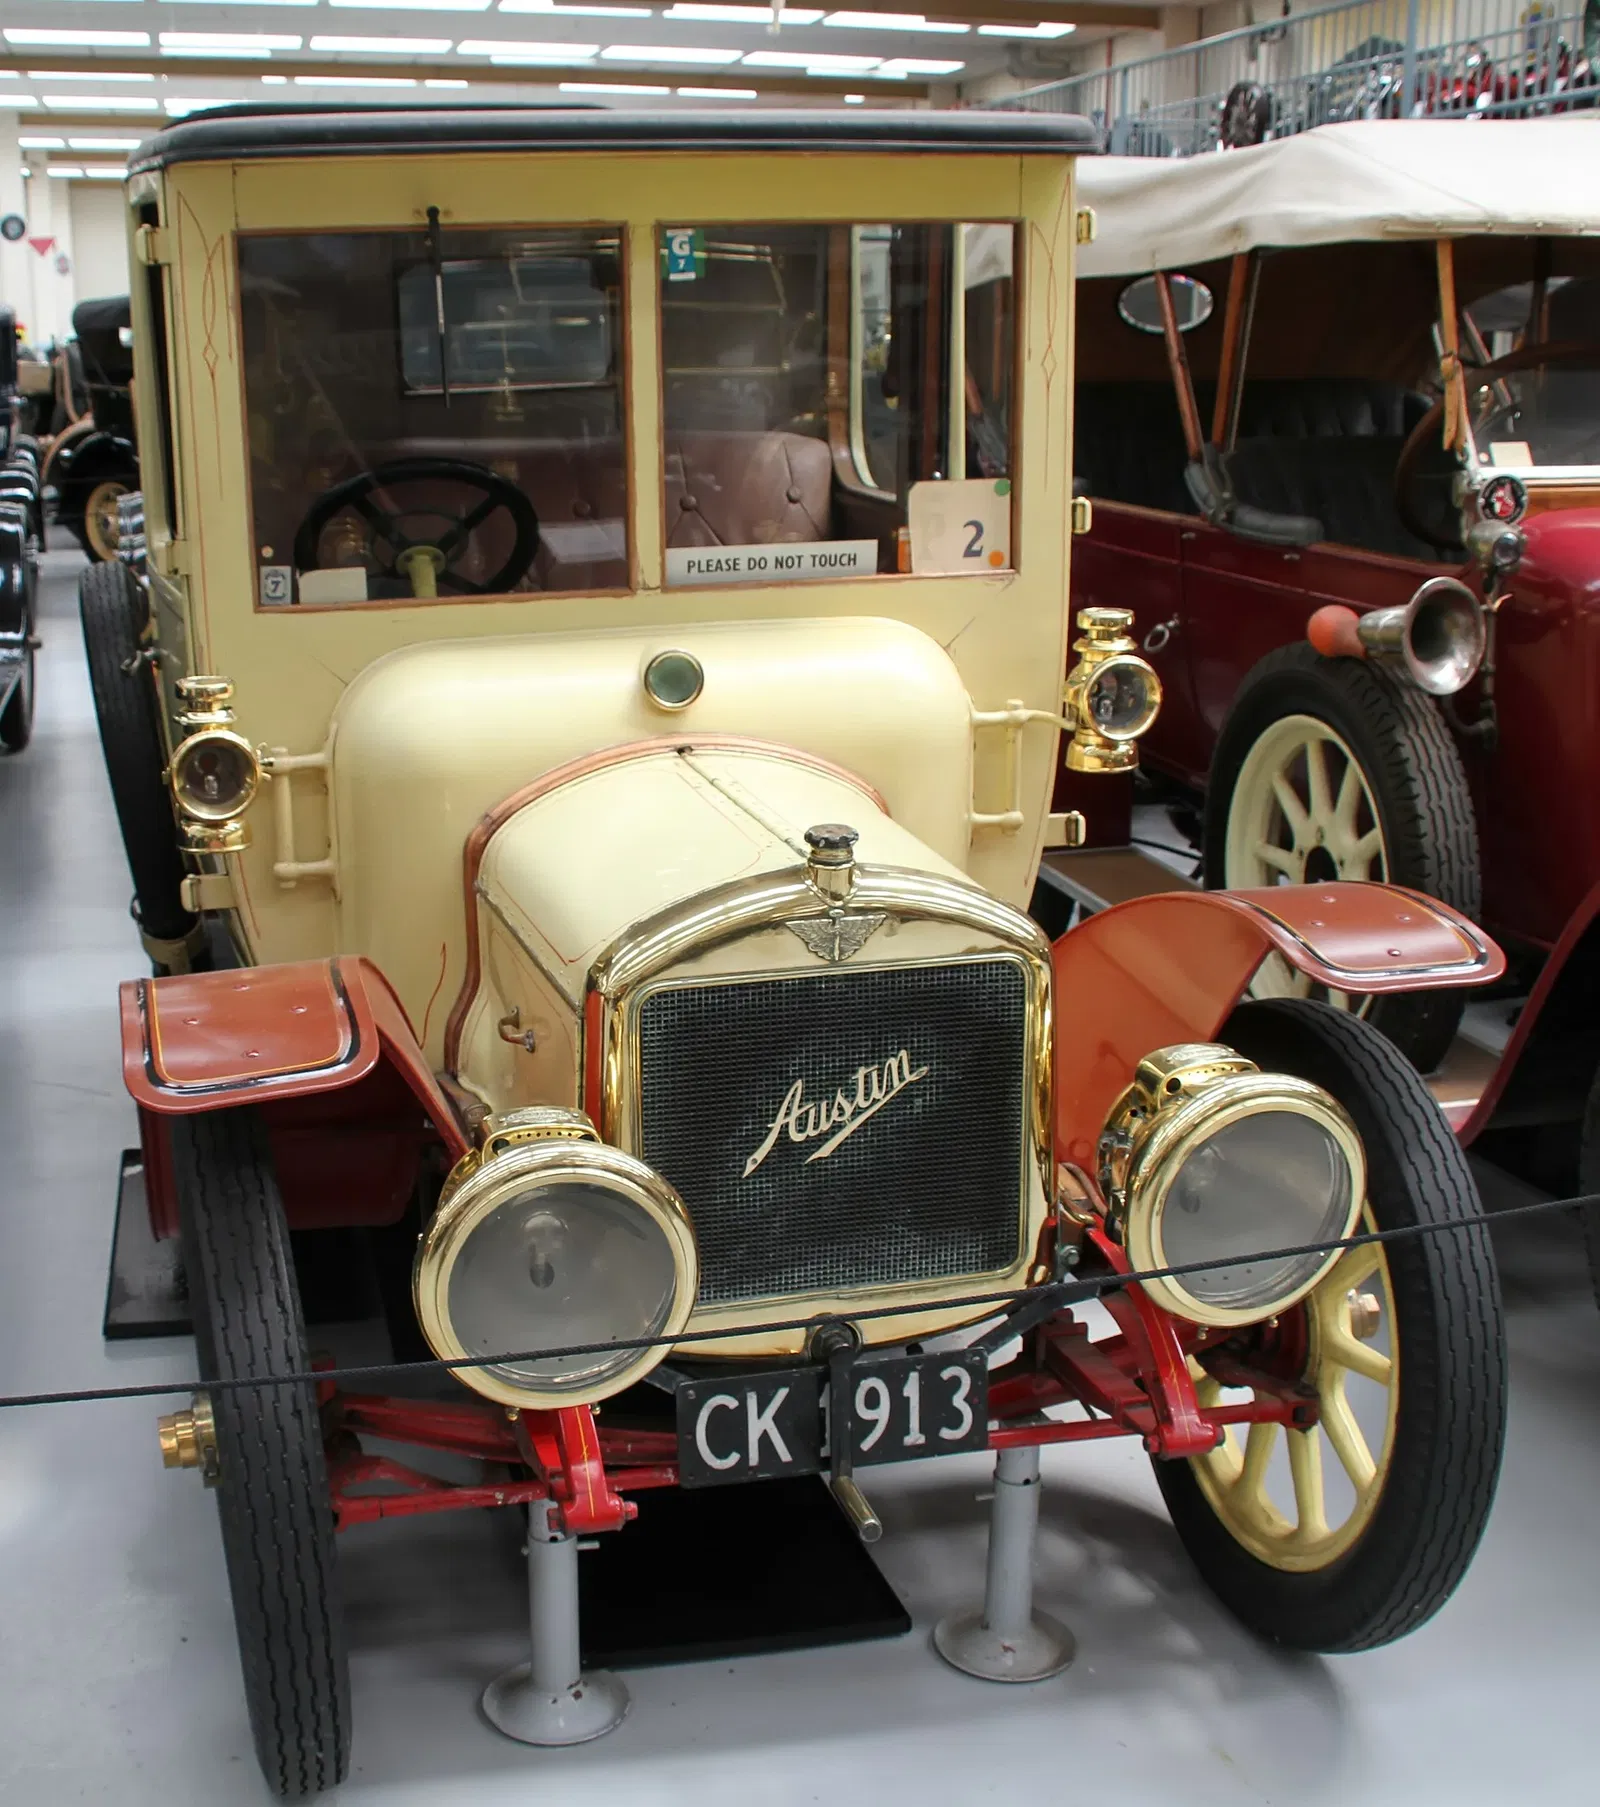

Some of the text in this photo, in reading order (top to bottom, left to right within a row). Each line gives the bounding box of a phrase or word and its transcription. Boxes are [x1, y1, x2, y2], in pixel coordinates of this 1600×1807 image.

[671, 235, 690, 256] G
[678, 258, 686, 270] 7
[963, 519, 984, 558] 2
[687, 552, 857, 574] PLEASE DO NOT TOUCH
[271, 580, 281, 593] 7
[742, 1048, 929, 1178] Austin
[695, 1386, 793, 1470] CK
